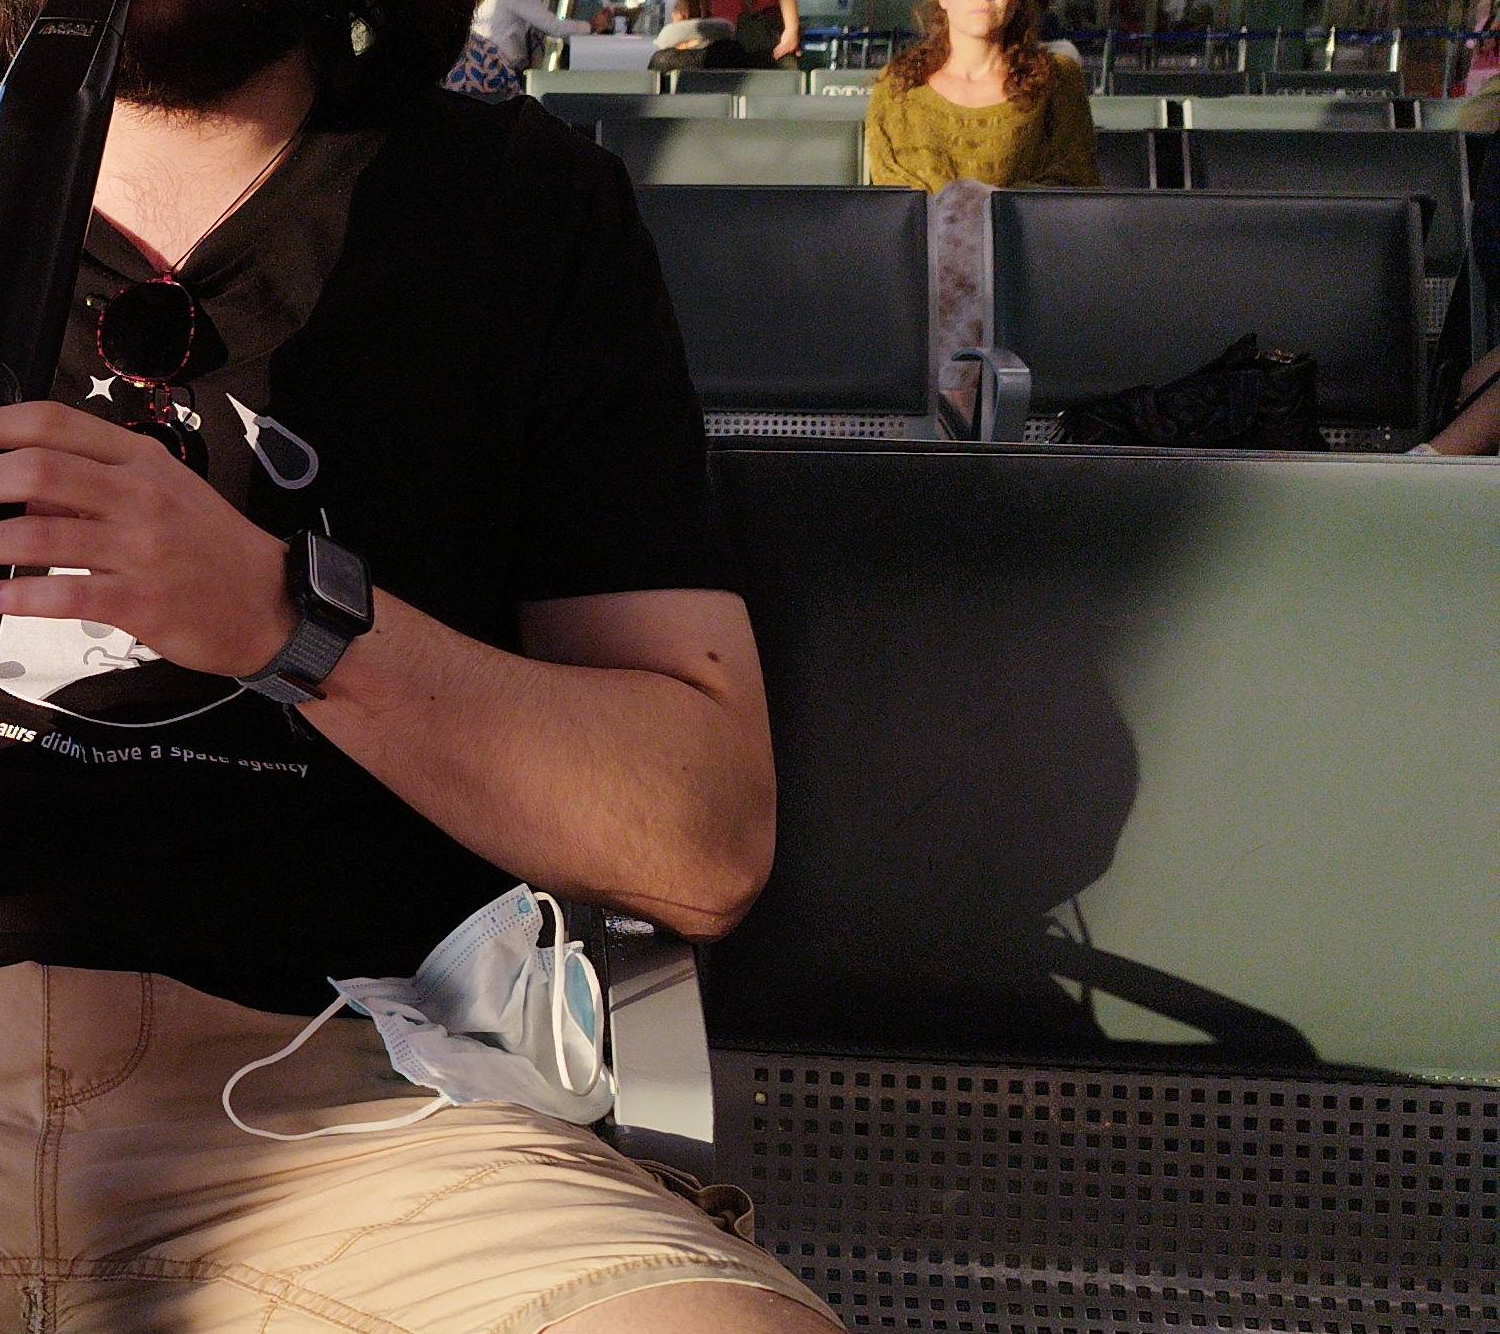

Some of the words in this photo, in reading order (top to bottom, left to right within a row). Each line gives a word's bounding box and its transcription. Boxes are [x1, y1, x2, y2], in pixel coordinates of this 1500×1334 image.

[92, 747, 143, 763] have
[150, 744, 162, 759] a
[238, 759, 308, 778] agency
